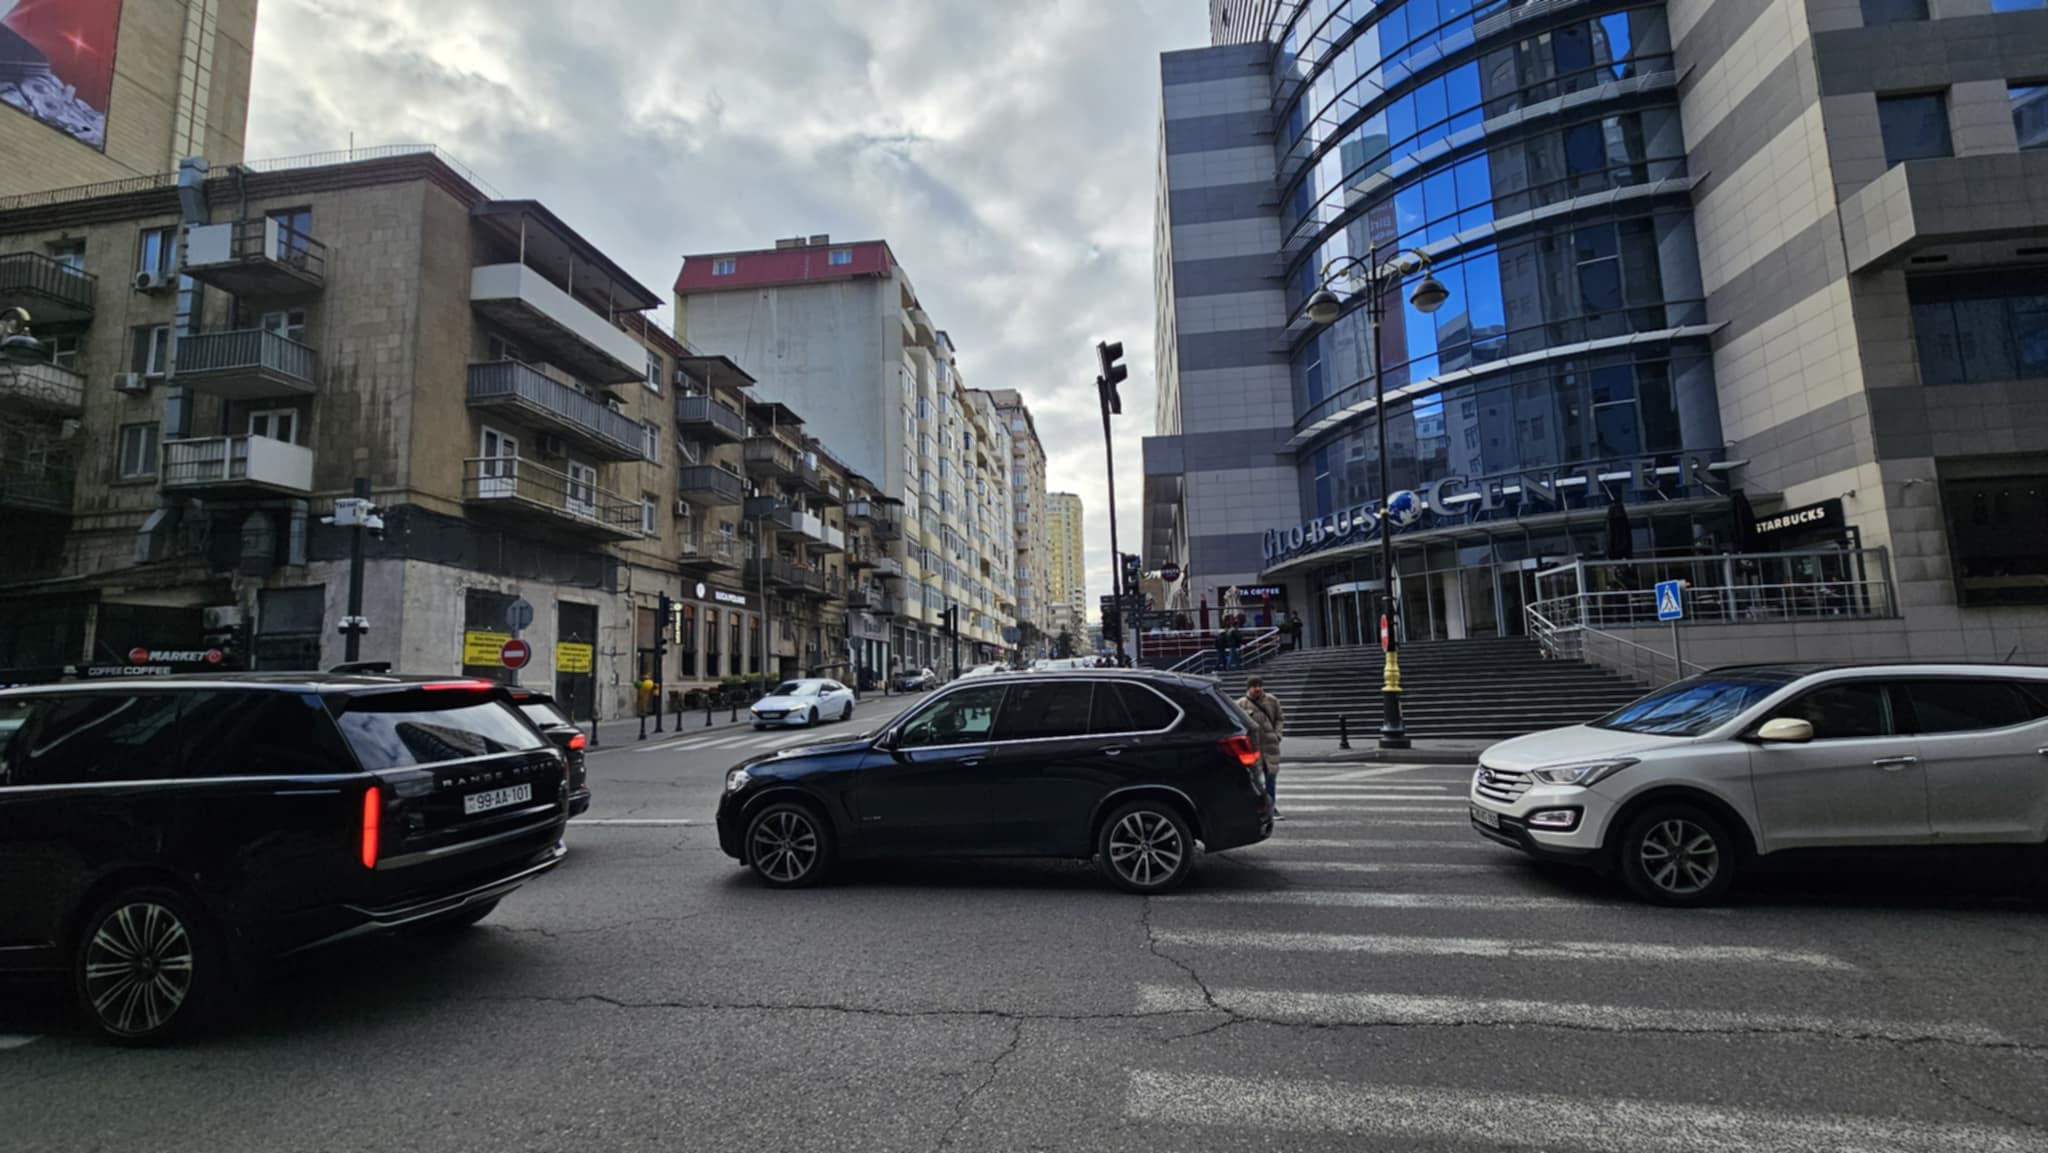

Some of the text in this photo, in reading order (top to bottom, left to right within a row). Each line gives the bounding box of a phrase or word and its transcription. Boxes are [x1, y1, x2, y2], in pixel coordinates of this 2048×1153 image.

[1262, 452, 1724, 560] GLOBUS CENTER
[148, 650, 207, 662] MARKET
[123, 666, 172, 675] COFFEE
